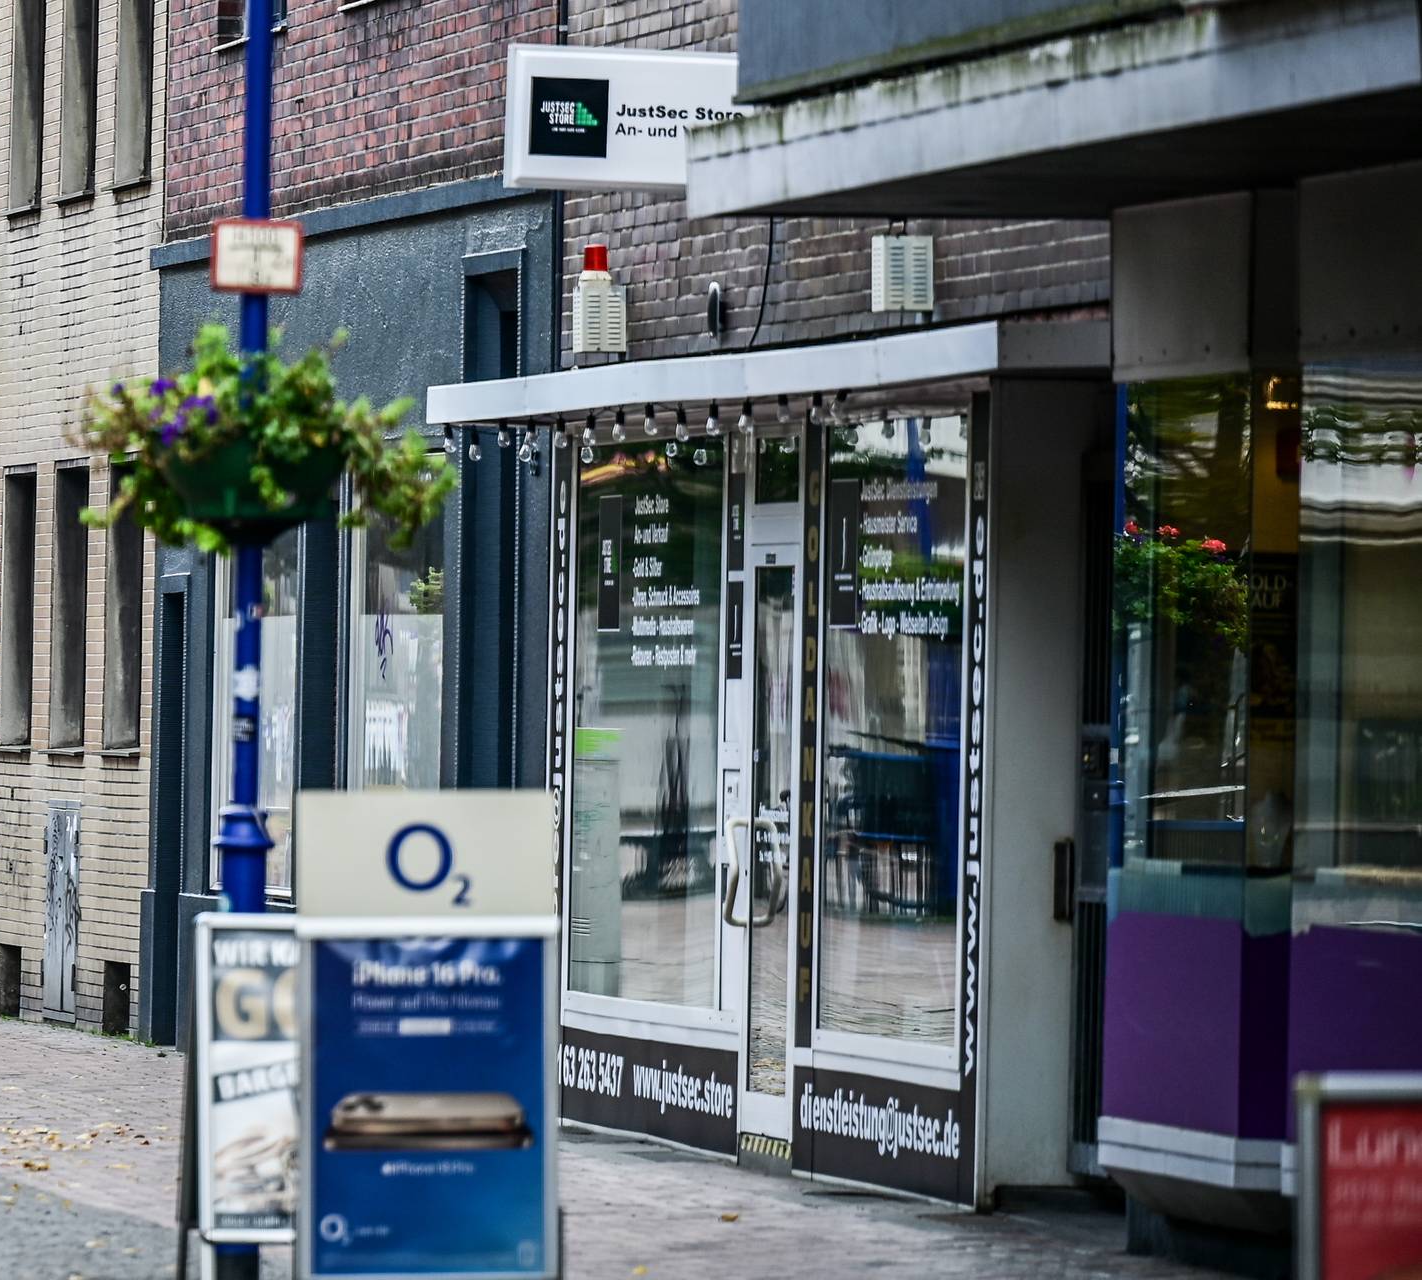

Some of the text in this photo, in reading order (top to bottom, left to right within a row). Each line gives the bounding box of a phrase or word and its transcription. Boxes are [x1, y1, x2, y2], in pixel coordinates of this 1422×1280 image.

[540, 101, 575, 113] JUSTSEC
[616, 104, 688, 119] JustSec
[548, 113, 575, 125] STORE
[615, 124, 642, 137] An-
[648, 125, 677, 138] und
[635, 494, 654, 515] JustSec
[964, 515, 985, 1078] www.justsec.de
[214, 941, 266, 966] WIR
[352, 962, 426, 987] iPhone
[577, 1047, 596, 1093] 263
[598, 1051, 624, 1099] 5437
[633, 1059, 733, 1119] www.justsec.store
[800, 1083, 960, 1159] dienstleistung@justsec.de
